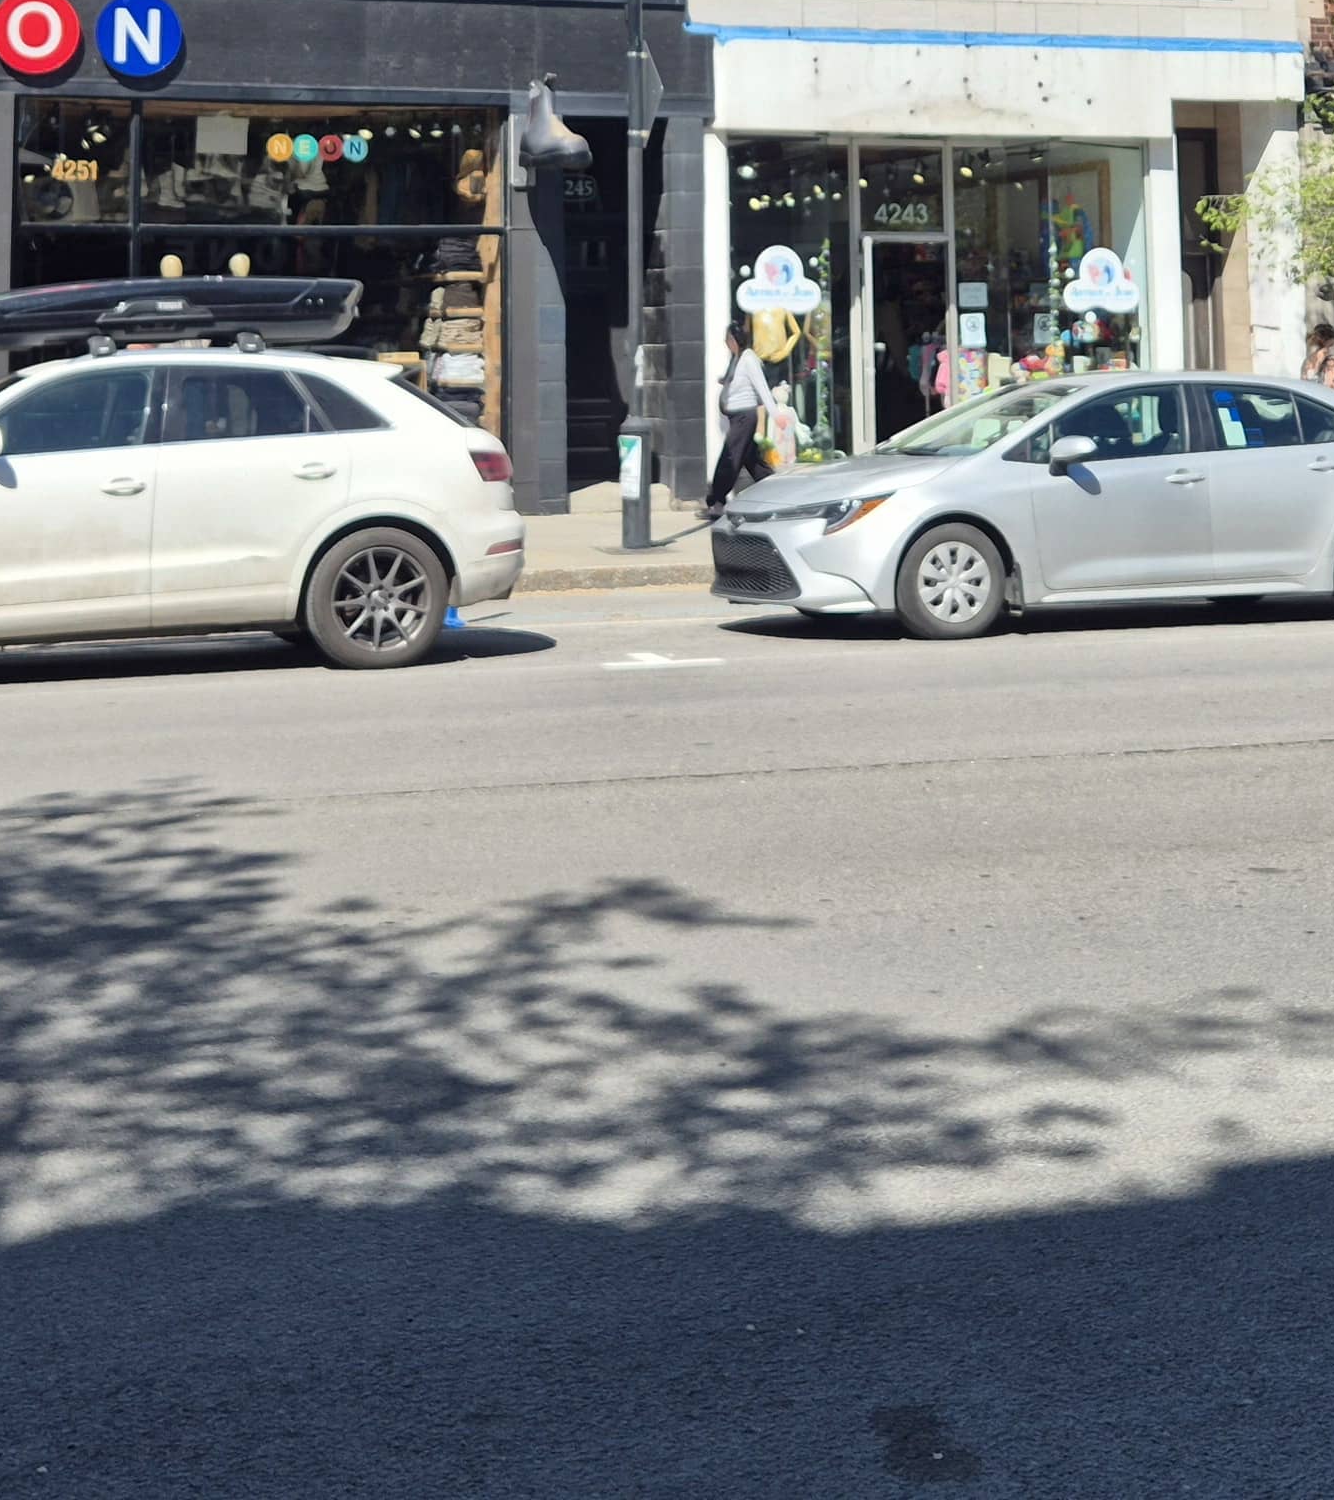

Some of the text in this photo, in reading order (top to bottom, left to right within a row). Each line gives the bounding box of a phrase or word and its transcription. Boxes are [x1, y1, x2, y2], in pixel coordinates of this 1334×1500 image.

[270, 136, 365, 159] NEON
[50, 159, 99, 182] 4251
[563, 179, 594, 197] 245
[873, 202, 929, 225] 4243
